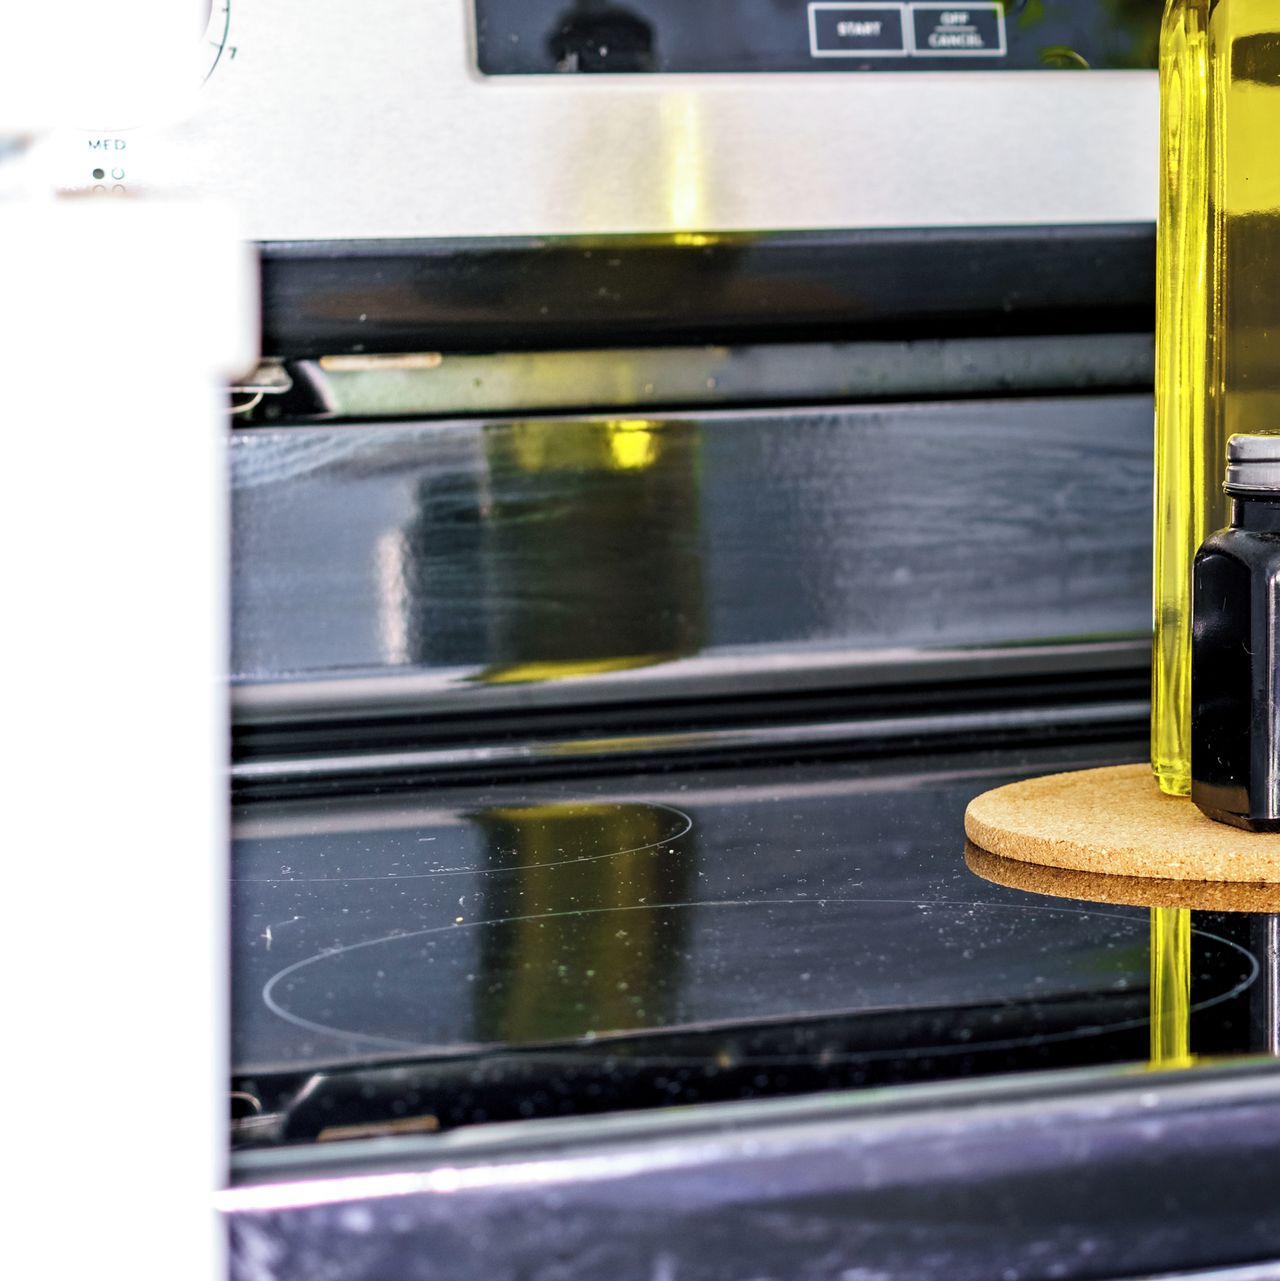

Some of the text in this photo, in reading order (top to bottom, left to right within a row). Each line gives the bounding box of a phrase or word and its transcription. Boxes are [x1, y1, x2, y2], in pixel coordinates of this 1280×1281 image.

[837, 21, 882, 37] START
[929, 32, 985, 48] CANCEL
[228, 47, 239, 60] 7
[88, 139, 126, 151] MED
